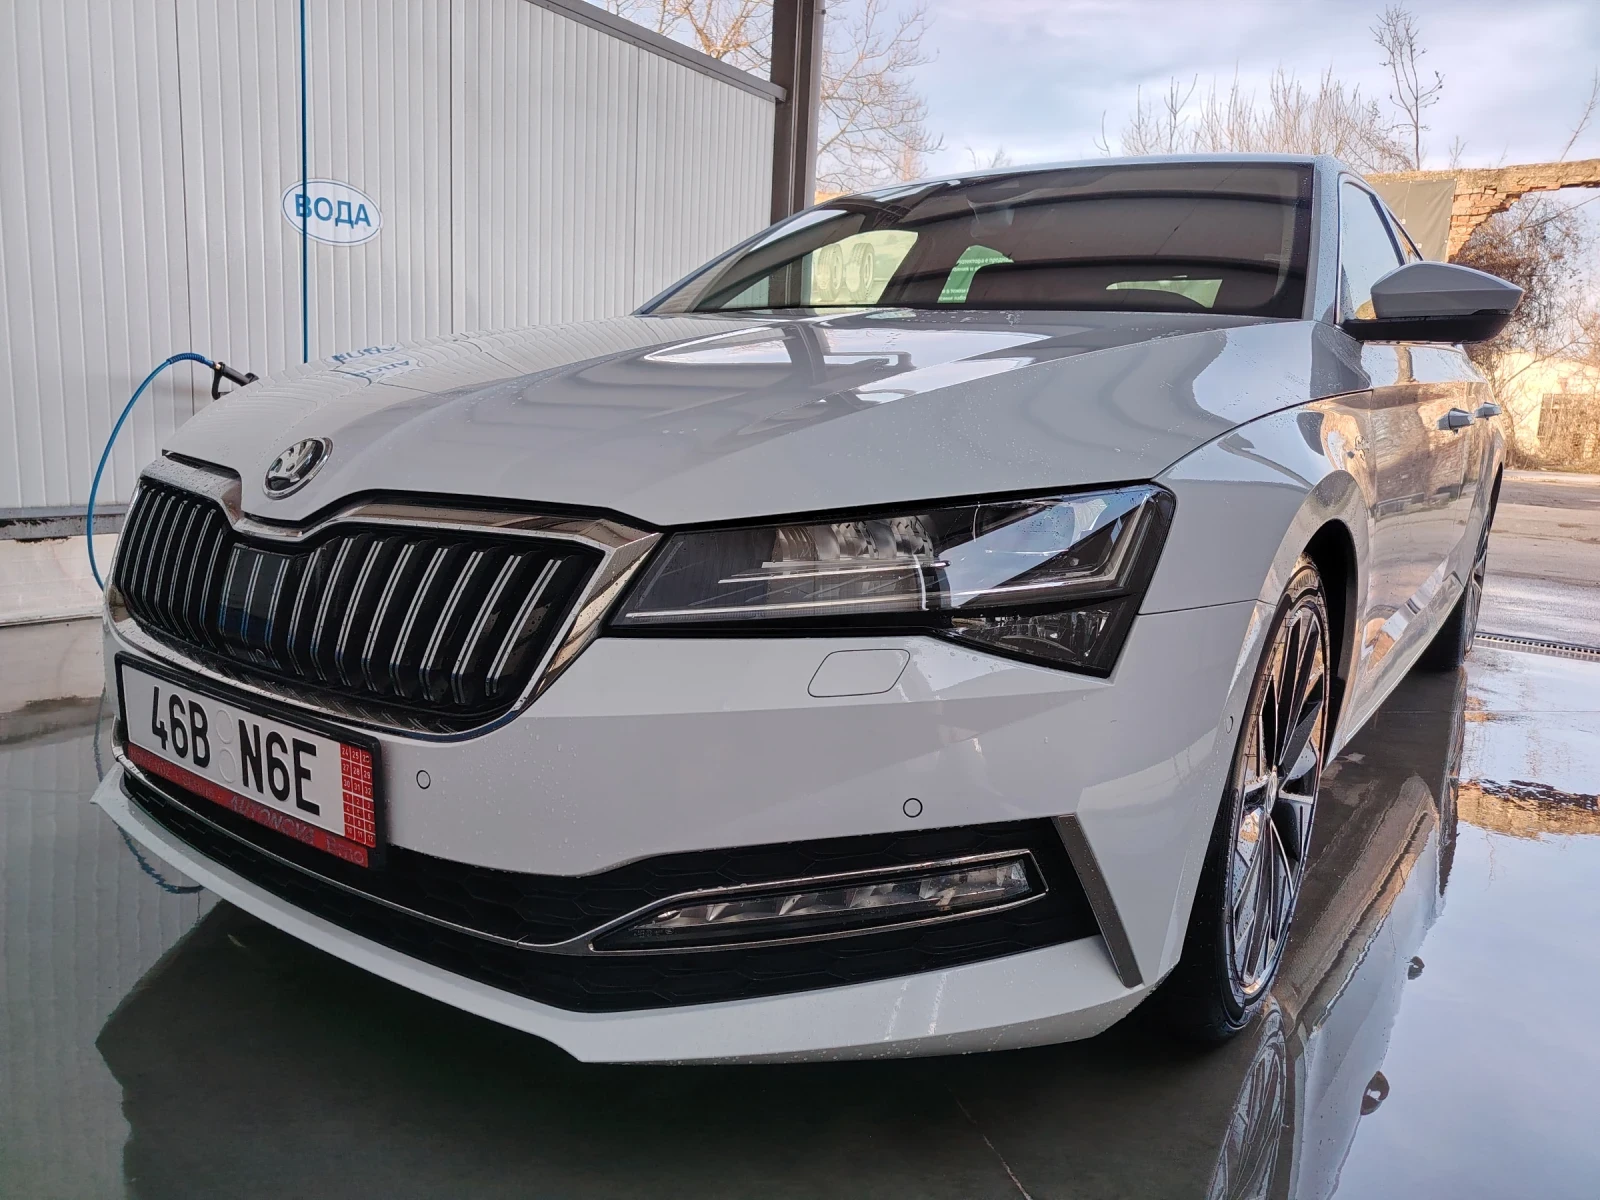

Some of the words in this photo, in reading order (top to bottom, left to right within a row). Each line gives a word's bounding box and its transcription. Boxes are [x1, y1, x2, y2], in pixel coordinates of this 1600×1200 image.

[295, 193, 372, 229] ВОДА
[152, 686, 211, 768] 46B
[238, 719, 320, 816] N6E
